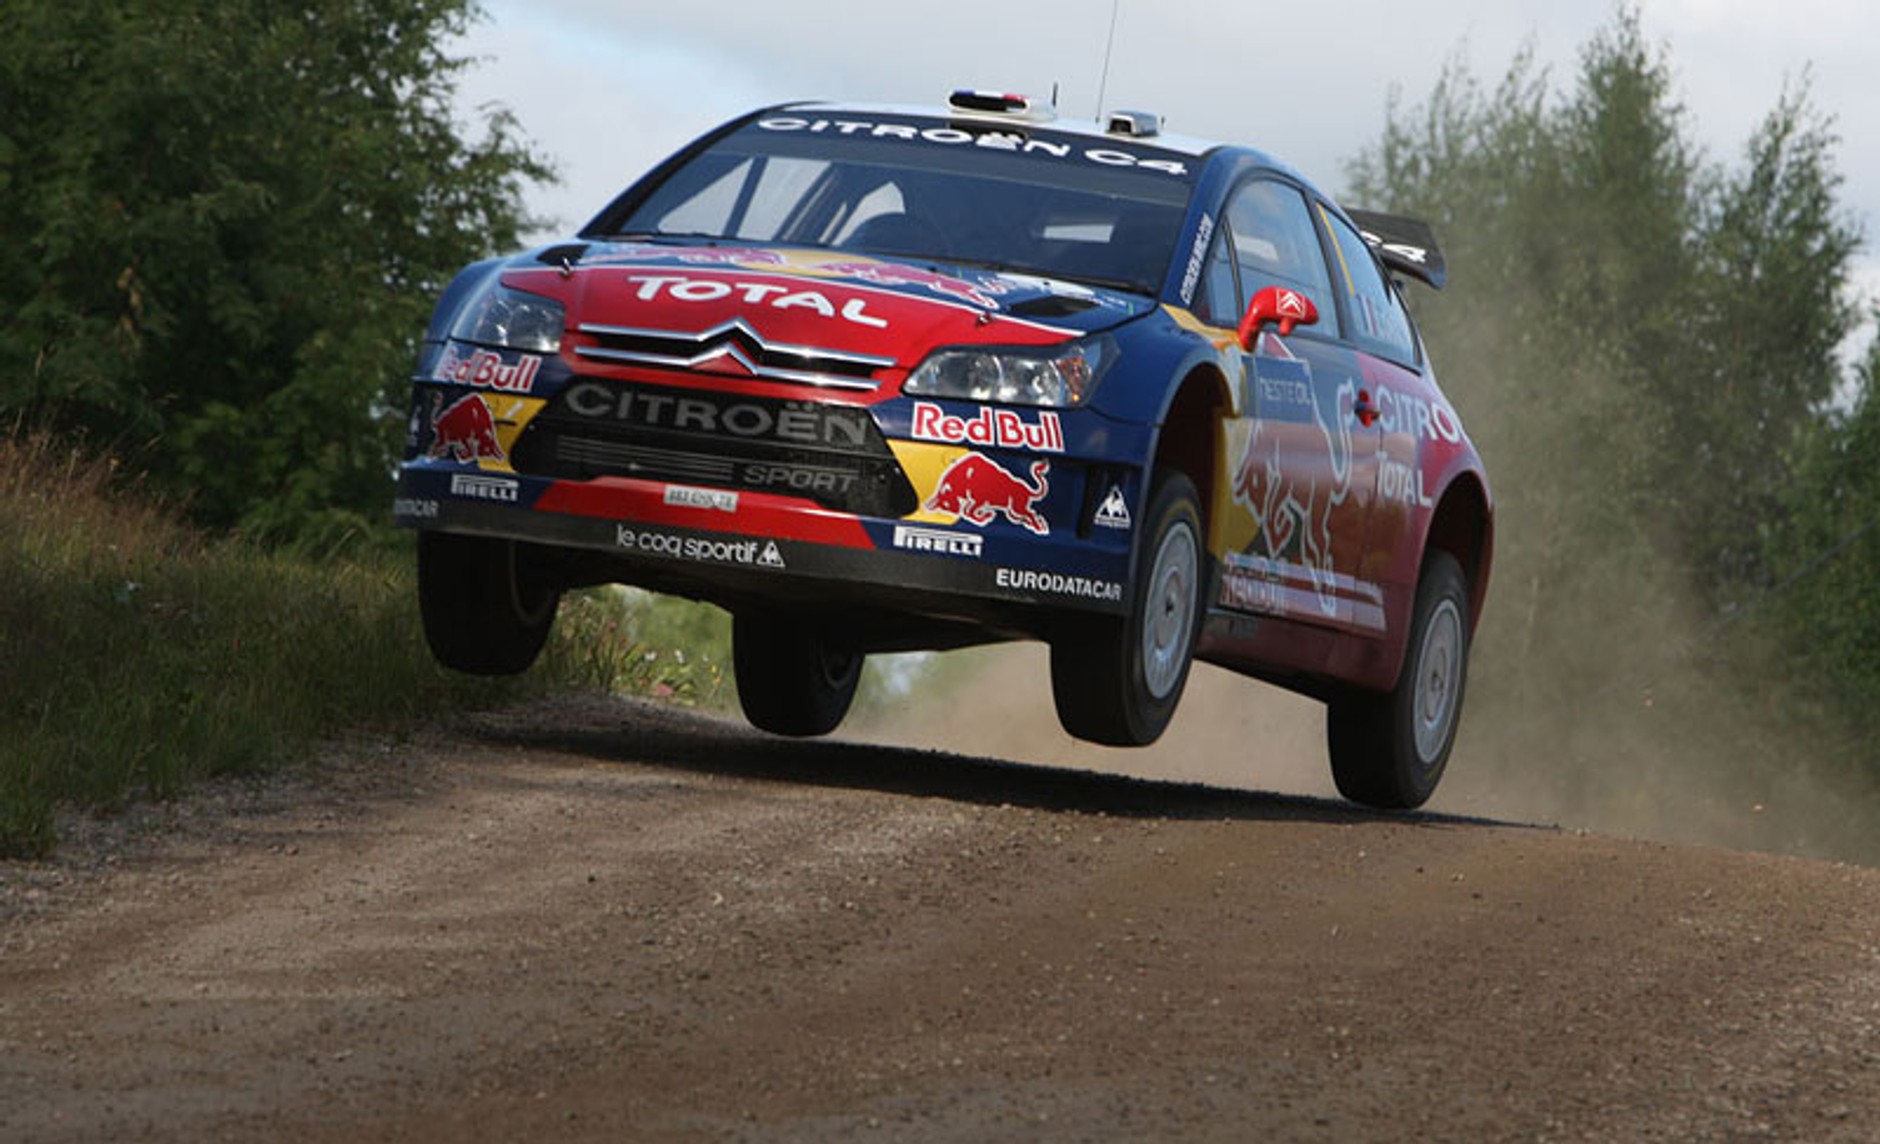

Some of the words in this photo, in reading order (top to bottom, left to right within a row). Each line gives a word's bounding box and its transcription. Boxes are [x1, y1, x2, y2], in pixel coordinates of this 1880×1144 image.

[1084, 149, 1188, 176] C4
[627, 276, 887, 327] TOTAL
[471, 353, 541, 392] Bull
[566, 383, 867, 445] CITROËN
[912, 402, 992, 446] Red
[995, 409, 1065, 451] Bull
[451, 474, 518, 500] PIRELLI
[744, 464, 860, 493] SPORT
[1376, 450, 1433, 508] TOTAL
[616, 524, 635, 547] le
[638, 532, 682, 558] coq
[684, 537, 758, 563] sportif
[894, 525, 983, 556] PIRELLI
[996, 568, 1122, 600] EURODATACAR
